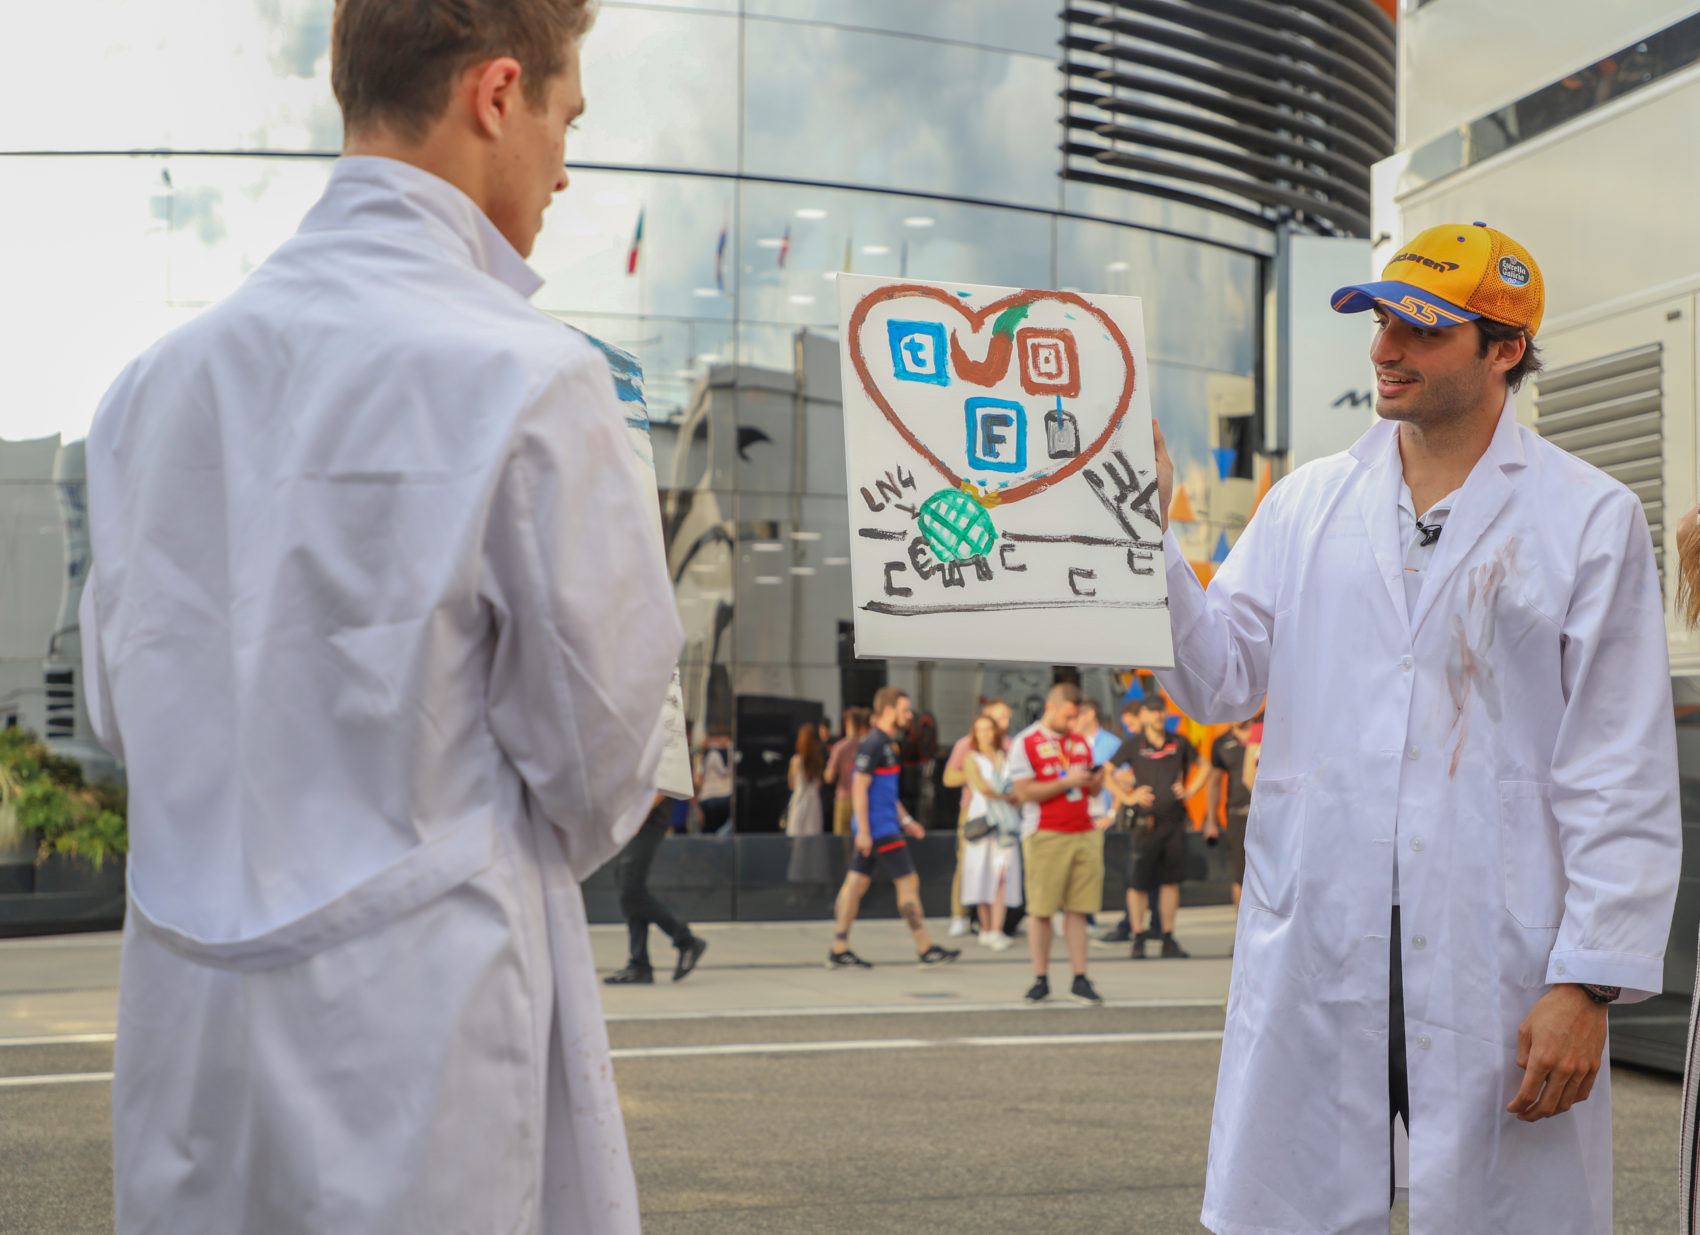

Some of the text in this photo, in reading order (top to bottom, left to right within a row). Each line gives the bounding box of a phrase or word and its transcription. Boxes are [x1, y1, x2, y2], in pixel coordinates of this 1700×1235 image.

[1502, 260, 1526, 275] Estrella
[1400, 295, 1438, 326] 55
[981, 413, 1015, 459] F
